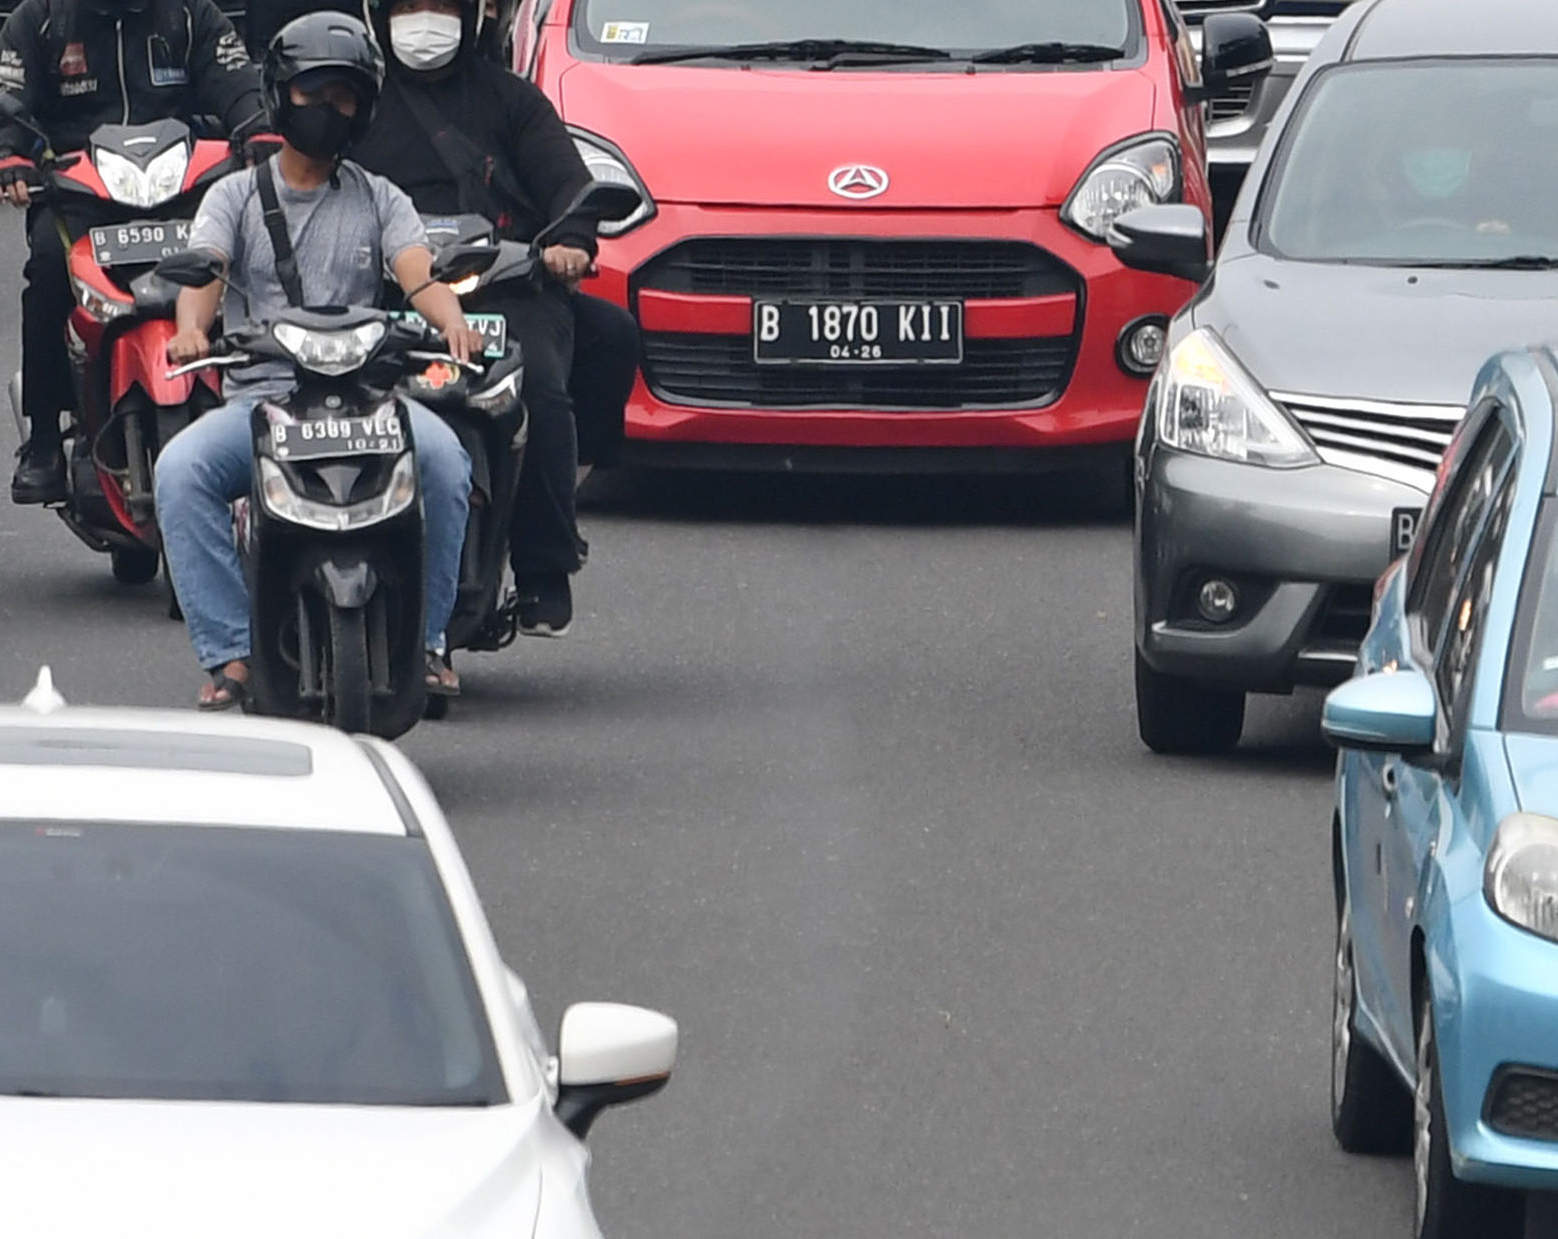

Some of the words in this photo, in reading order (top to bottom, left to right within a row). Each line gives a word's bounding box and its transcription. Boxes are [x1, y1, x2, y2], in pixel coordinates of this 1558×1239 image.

[94, 230, 107, 246] B
[117, 226, 164, 244] 6590
[176, 223, 195, 240] K
[761, 305, 780, 341] B
[808, 305, 878, 341] 1870
[899, 305, 950, 341] KII
[275, 424, 287, 443] B
[1398, 514, 1415, 549] B
